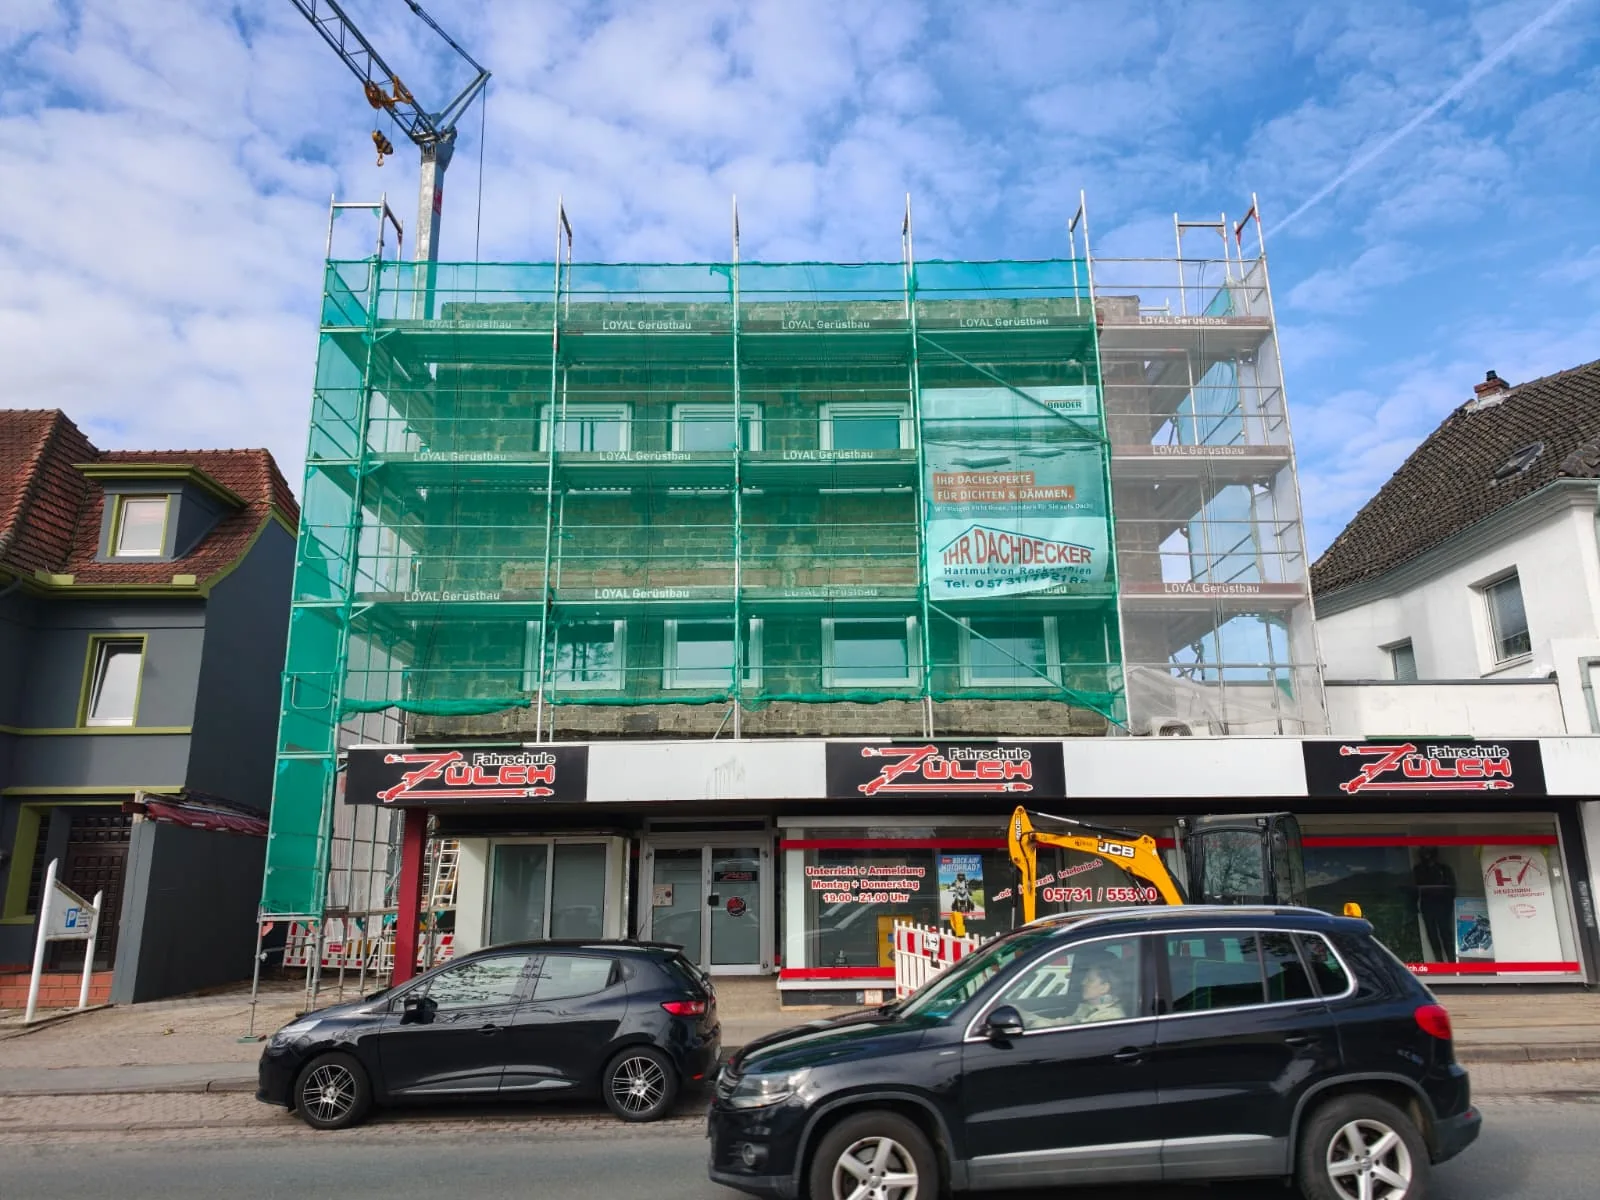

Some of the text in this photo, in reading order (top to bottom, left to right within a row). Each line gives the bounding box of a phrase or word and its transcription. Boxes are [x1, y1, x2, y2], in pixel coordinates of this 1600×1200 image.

[602, 320, 692, 330] LOYAL Gerüstbau
[782, 320, 870, 329] LOYAL Gerüstbau
[960, 316, 1048, 328] LOYAL Gerüstbau
[600, 451, 690, 460] LOYAL Gerüstbau
[784, 450, 874, 460] LOYAL Gerüstbau
[1152, 446, 1245, 455] LOYAL Gerüstbau
[414, 452, 506, 462] LOYAL Gerüstbau
[936, 474, 1032, 485] IHR DACHEXPERTE
[937, 486, 1072, 500] FÜR DICHTEN & DÄMMEN.
[944, 529, 1092, 566] IHR DACHDECKER
[944, 566, 990, 575] Hartmut
[944, 580, 970, 588] Tel.
[1164, 582, 1260, 593] LOYAL Gerüstbau
[404, 590, 500, 602] LOYAL Gerüstbau
[594, 588, 690, 599] LOYAL Gerüstbau
[948, 746, 1032, 760] Fahrschule
[1426, 745, 1510, 759] Fahrschule
[473, 752, 556, 766] Fahrschule
[858, 744, 1034, 796] ZÜLCH
[1340, 743, 1514, 794] ZÜLCH
[376, 751, 556, 802] ZÜLCH
[1098, 842, 1135, 858] JCB
[806, 866, 926, 878] Unterricht + Anmeldung
[1058, 858, 1103, 880] telefonisch
[812, 880, 920, 892] Montag + Donnerstag
[824, 893, 851, 903] 19.00
[860, 893, 888, 902] 21.00
[890, 893, 910, 902] Uhr
[1043, 888, 1092, 902] 05731
